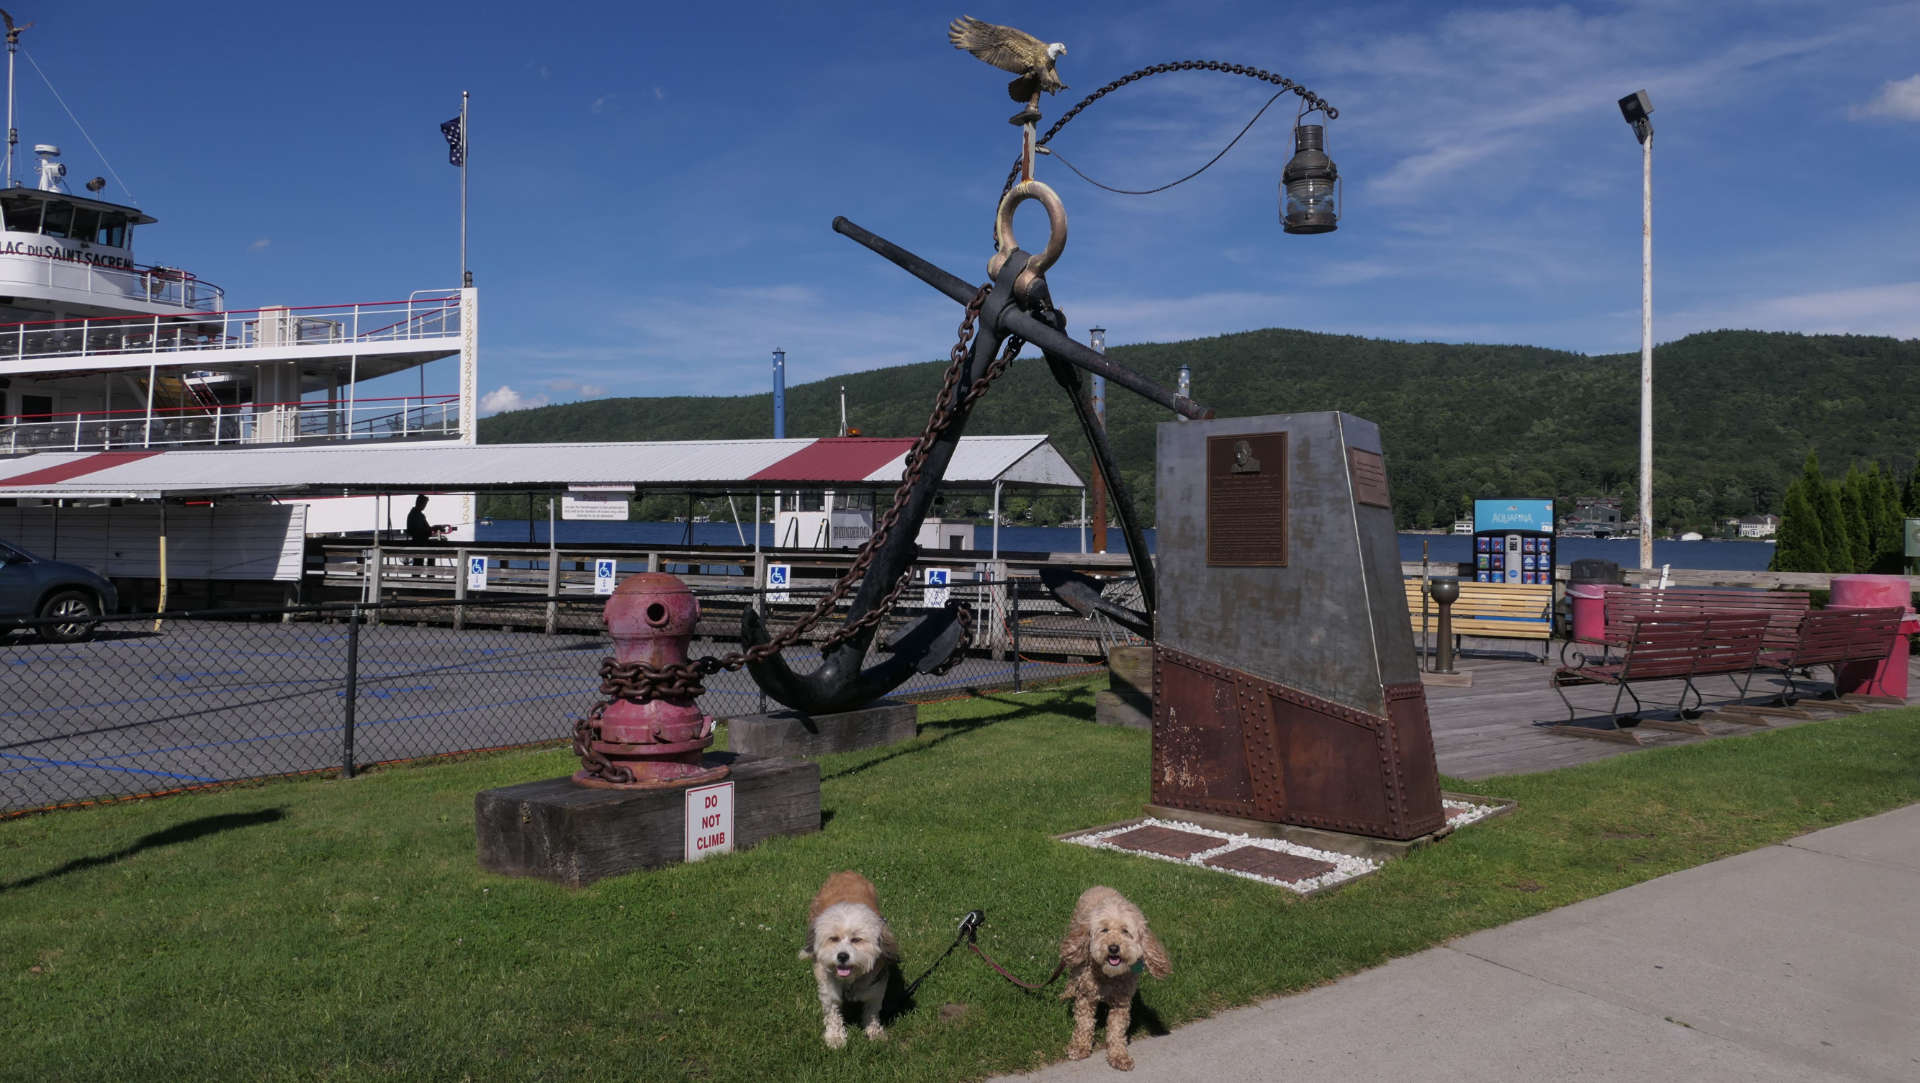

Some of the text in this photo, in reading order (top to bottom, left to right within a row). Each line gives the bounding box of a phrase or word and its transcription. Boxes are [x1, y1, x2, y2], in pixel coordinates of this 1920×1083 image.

[27, 244, 43, 257] DU
[45, 245, 83, 263] SAINT
[705, 795, 718, 808] DO
[702, 814, 721, 829] NOT
[697, 833, 725, 850] CLIMB
